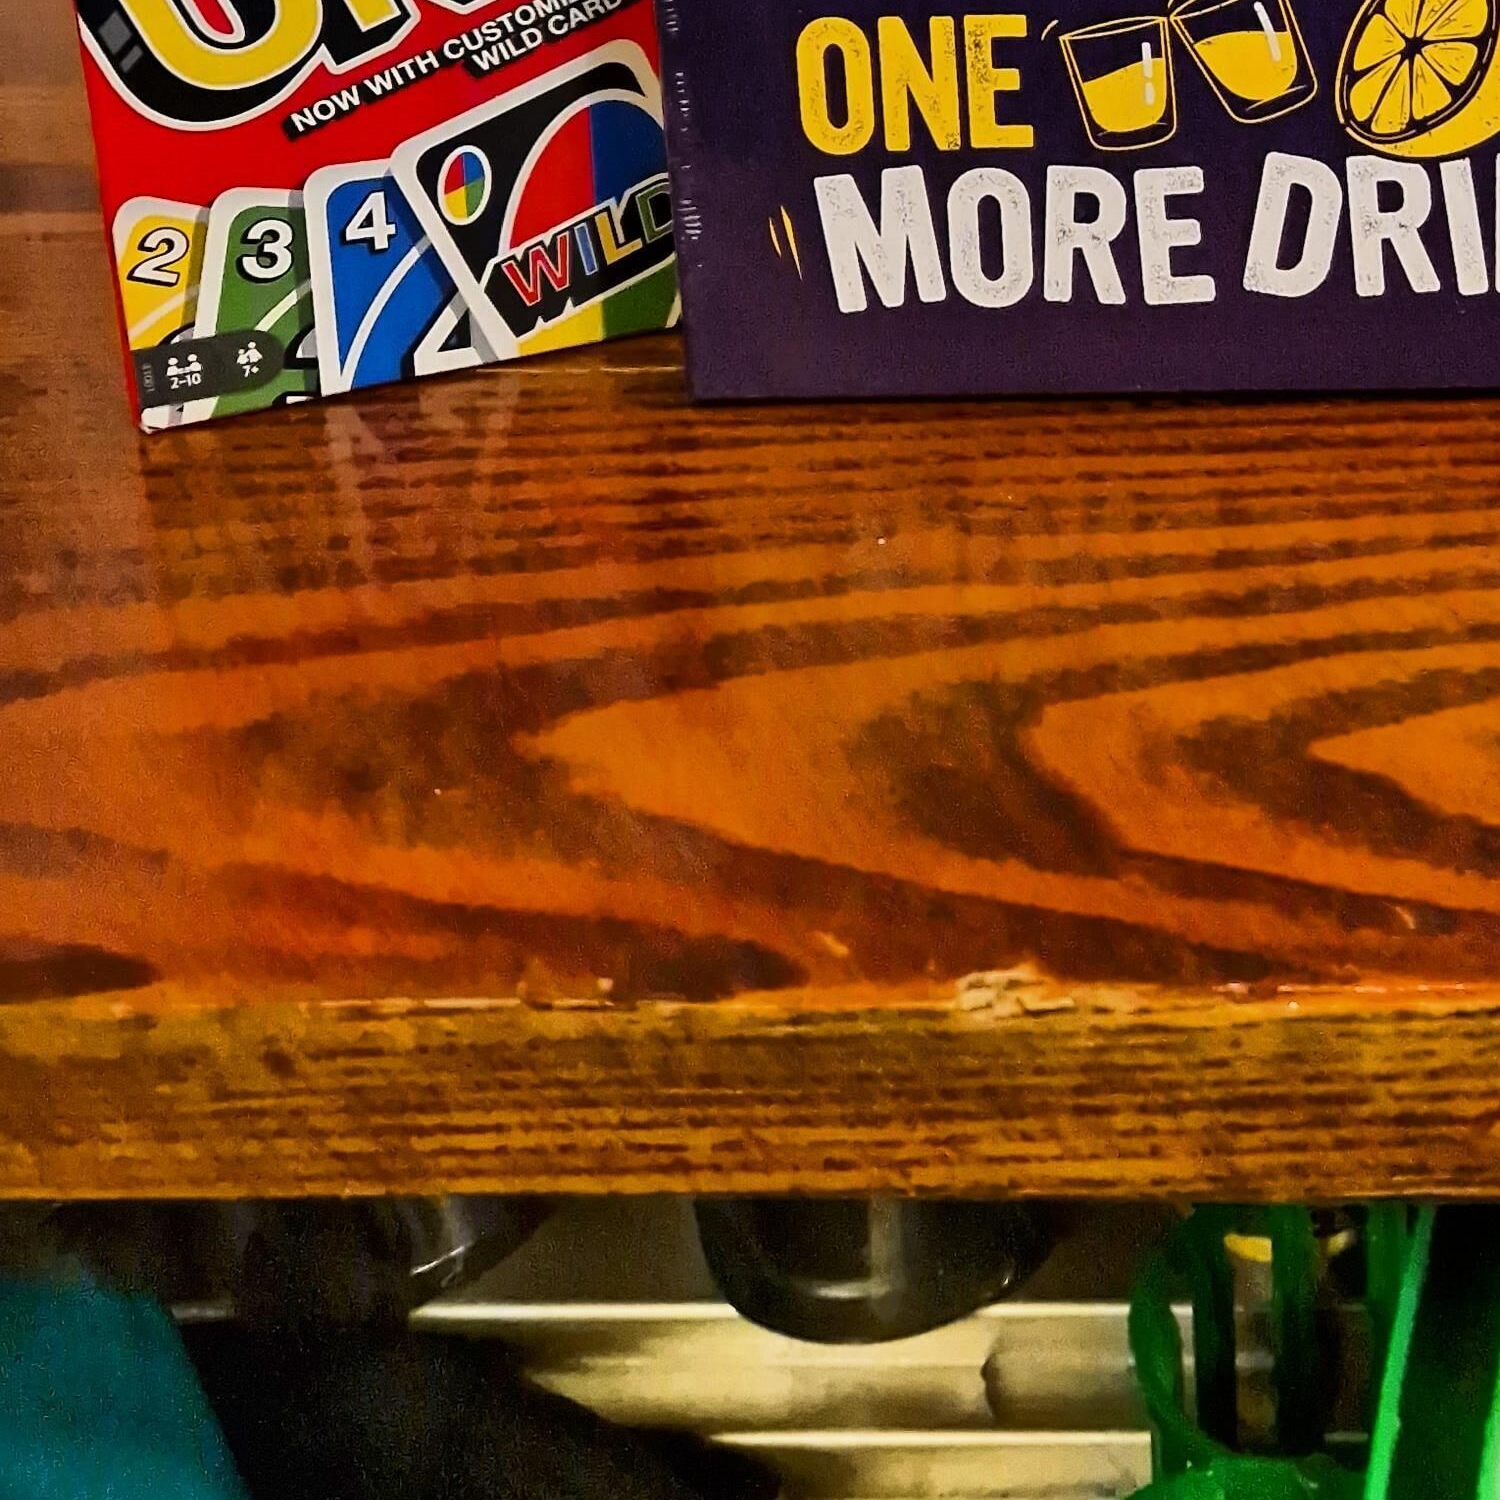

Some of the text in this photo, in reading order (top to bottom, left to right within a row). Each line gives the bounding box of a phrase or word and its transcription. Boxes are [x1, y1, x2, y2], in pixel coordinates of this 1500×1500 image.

[471, 26, 544, 72] WILD
[290, 85, 362, 133] NOW
[364, 50, 440, 98] WITH
[795, 13, 1034, 156] ONE
[243, 218, 294, 280] 3
[345, 191, 396, 250] 4
[501, 182, 673, 307] WILD
[812, 162, 1216, 313] MORE
[129, 228, 189, 287] 2
[170, 373, 202, 390] 2-10
